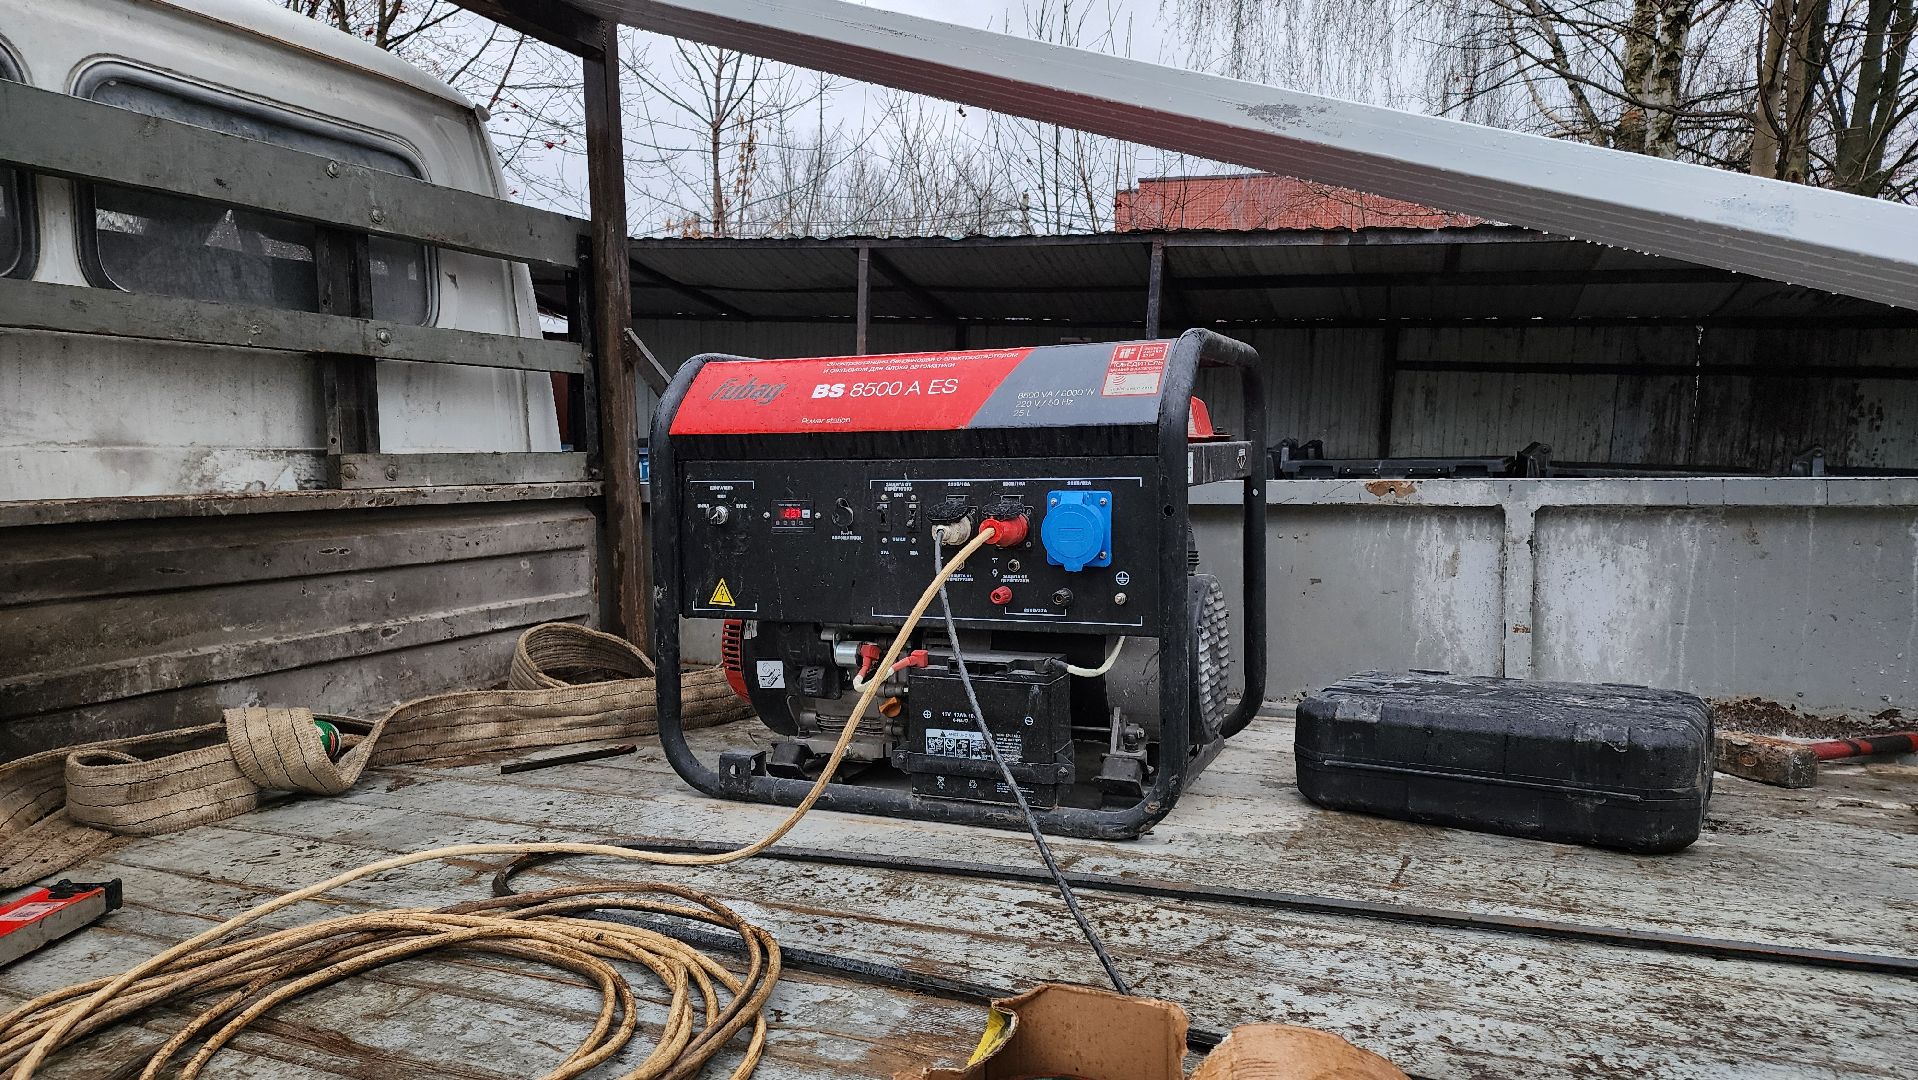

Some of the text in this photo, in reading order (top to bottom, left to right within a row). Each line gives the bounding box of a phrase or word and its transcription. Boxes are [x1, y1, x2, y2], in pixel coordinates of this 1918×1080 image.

[868, 365, 884, 373] для
[909, 362, 956, 370] автоматики
[709, 376, 788, 405] Fubag
[811, 378, 959, 399] BS 8500 A ES
[1017, 391, 1040, 400] 8500
[1041, 390, 1053, 398] VA
[1015, 400, 1032, 408] 220
[1047, 398, 1060, 406] 50
[1061, 398, 1074, 406] Hz
[1012, 409, 1032, 417] 25 L
[826, 416, 851, 424] station
